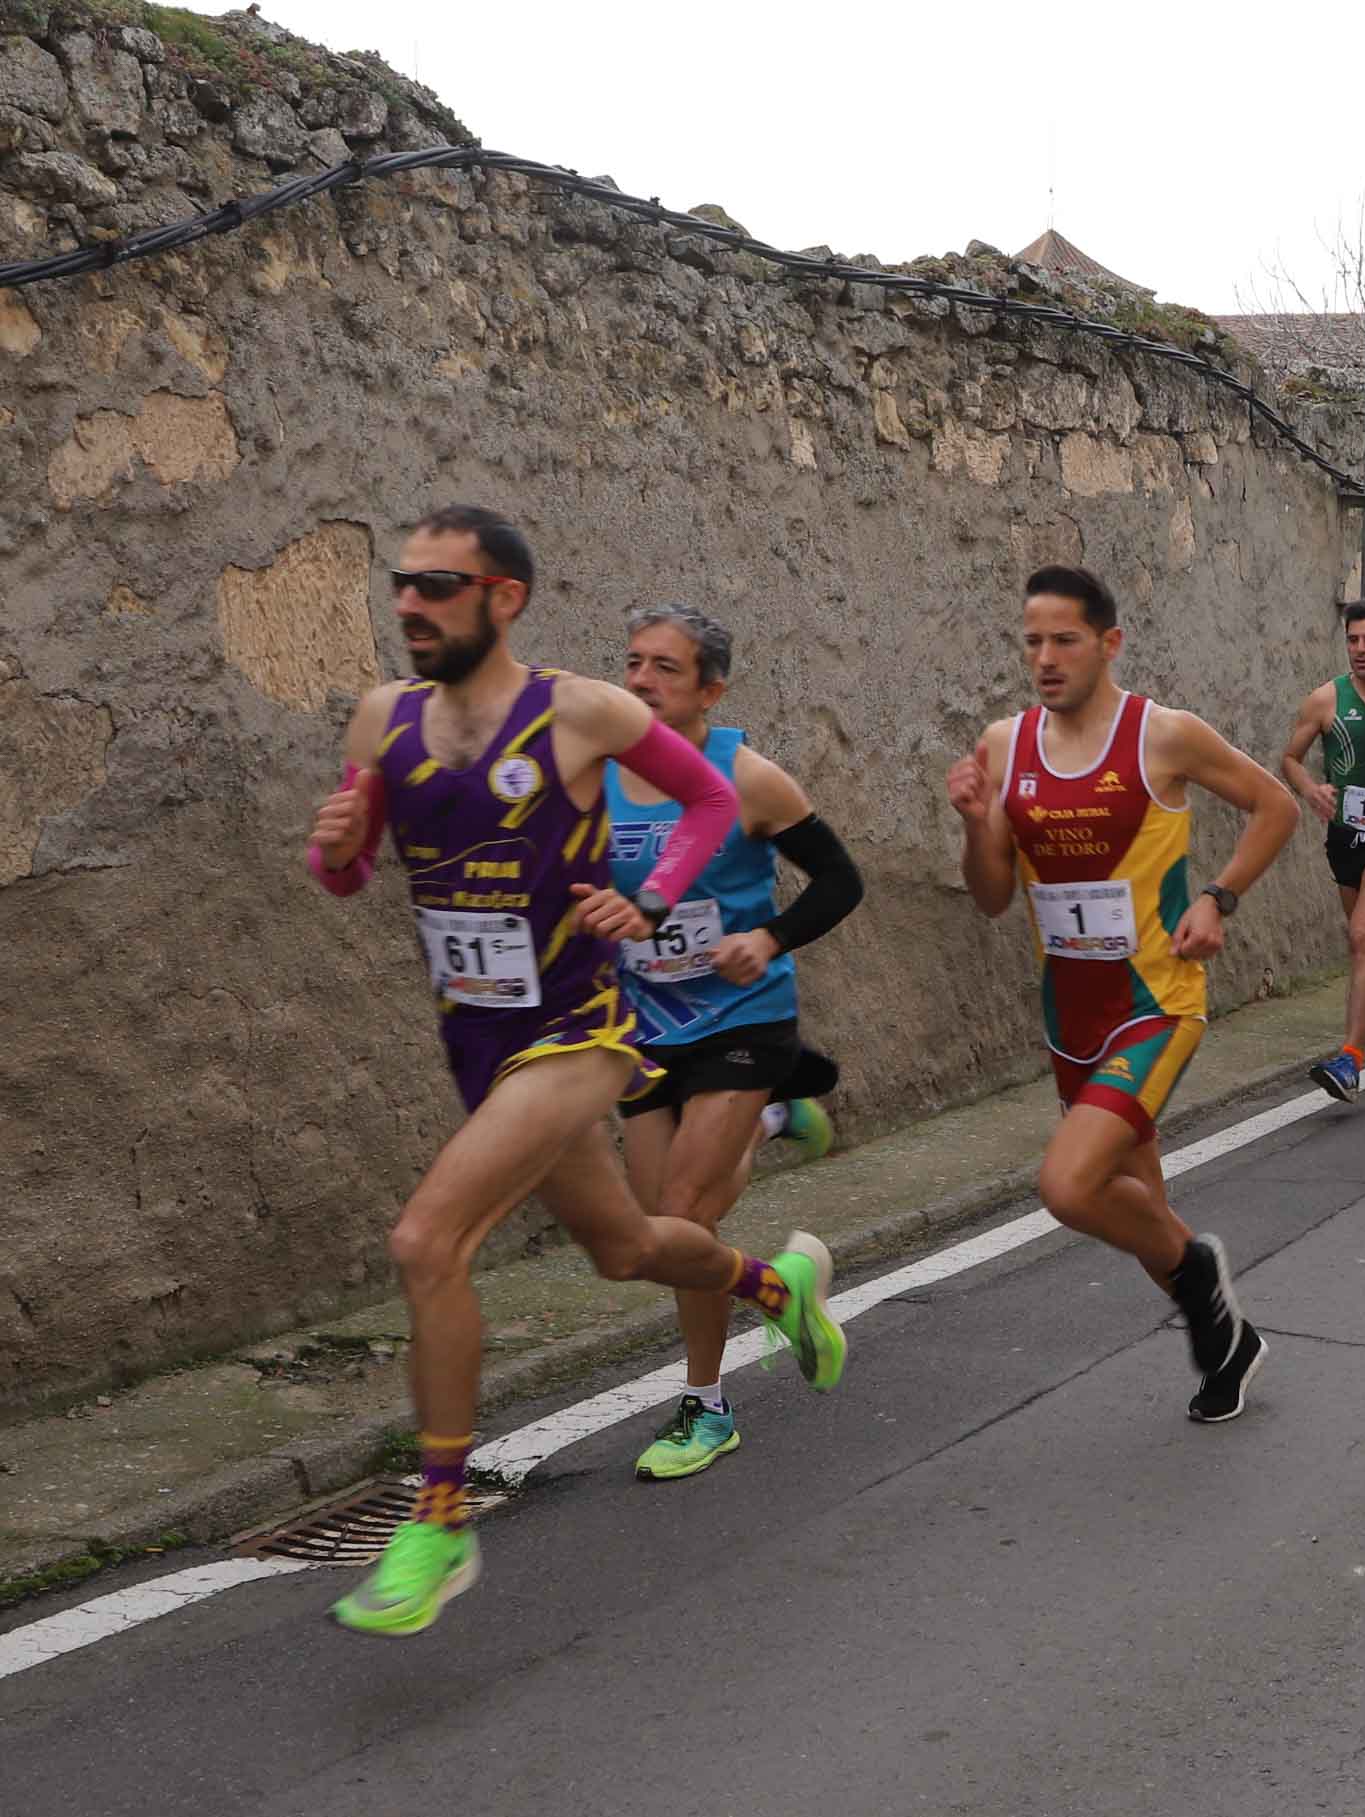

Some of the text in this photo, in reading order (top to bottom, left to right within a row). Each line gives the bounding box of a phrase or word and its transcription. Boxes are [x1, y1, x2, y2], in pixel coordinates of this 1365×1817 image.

[1046, 827, 1093, 841] VINO
[1032, 841, 1111, 857] DE TORO
[1068, 903, 1086, 935] 1
[444, 935, 488, 976] 61
